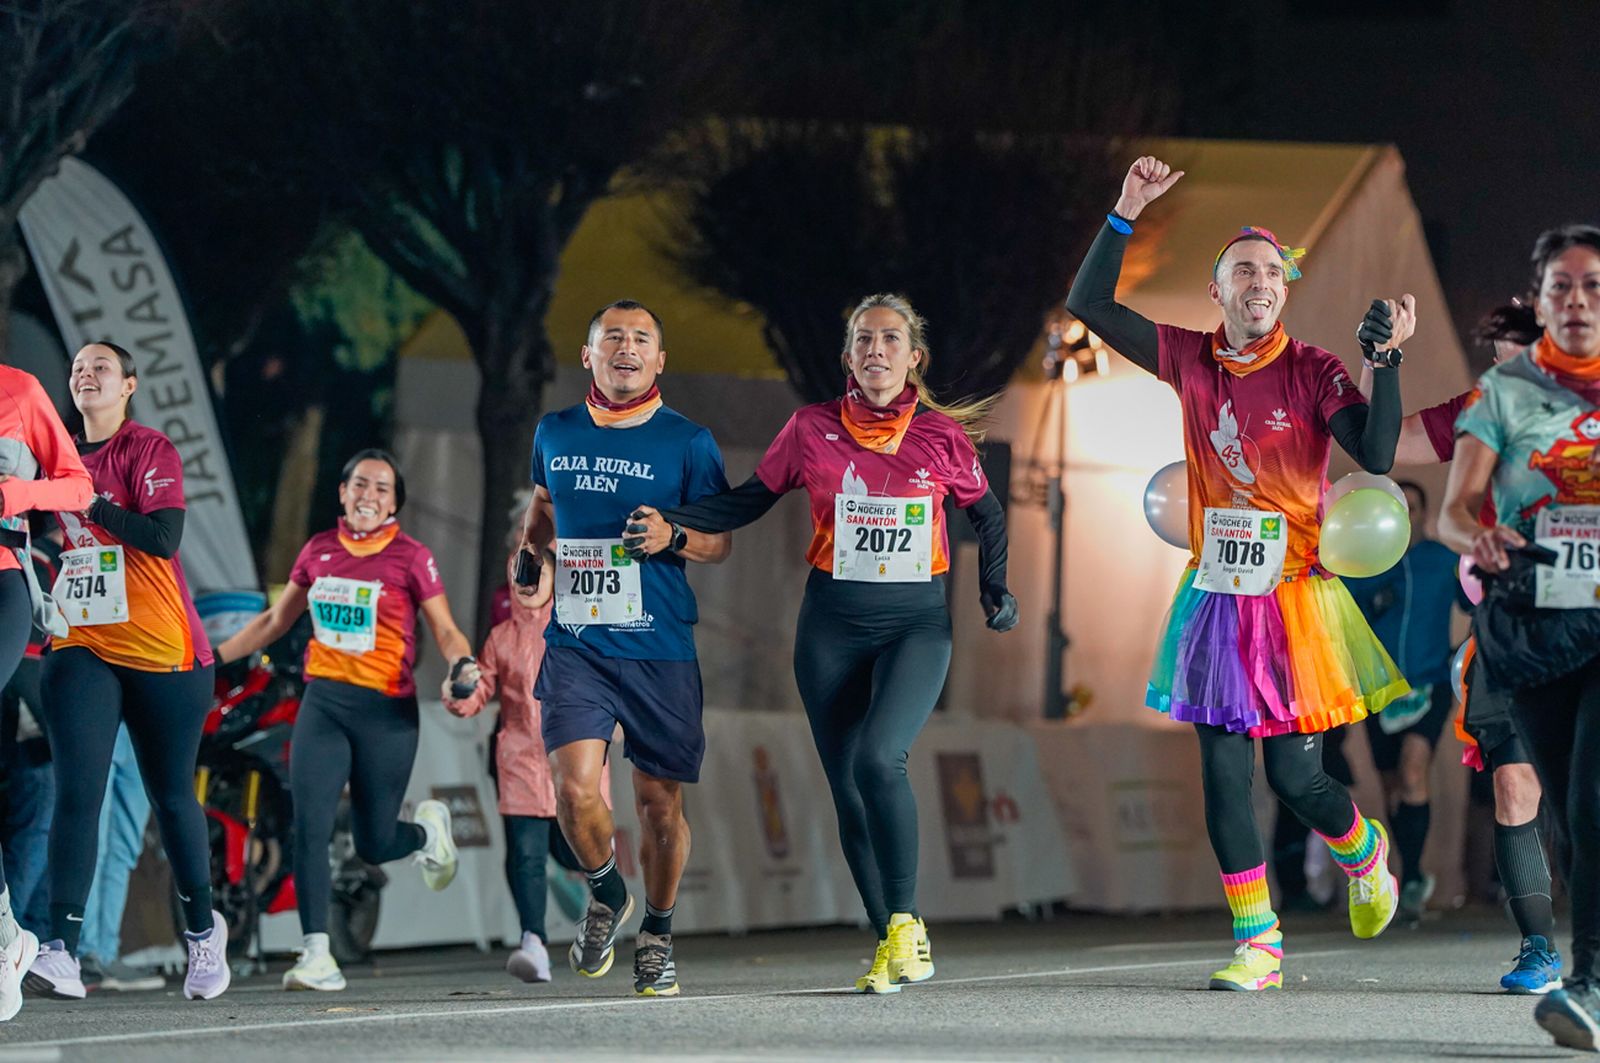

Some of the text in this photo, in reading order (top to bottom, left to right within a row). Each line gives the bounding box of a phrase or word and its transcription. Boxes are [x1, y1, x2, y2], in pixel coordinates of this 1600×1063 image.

[100, 224, 225, 506] JAPEMASA
[1221, 444, 1241, 468] 43
[550, 456, 655, 481] CAJA RURAL
[573, 474, 619, 494] JAÉN
[846, 515, 865, 525] SAN
[866, 514, 897, 527] ANTÓN
[857, 505, 885, 515] NOCHE
[886, 507, 897, 516] DE
[1564, 515, 1598, 525] NOCHE
[1210, 527, 1226, 538] SAN
[1225, 527, 1253, 540] ANTÓN
[1218, 516, 1241, 528] NOCHE
[1241, 519, 1253, 529] DE
[1550, 527, 1573, 538] SAN
[855, 527, 912, 553] 2072
[563, 559, 577, 568] SAN
[578, 557, 604, 569] ANTÓN
[569, 549, 603, 558] NOCHE DE
[1217, 538, 1266, 567] 7078
[1560, 541, 1600, 571] 76
[66, 575, 107, 600] 7574
[570, 570, 621, 595] 2073
[317, 602, 365, 627] 13739
